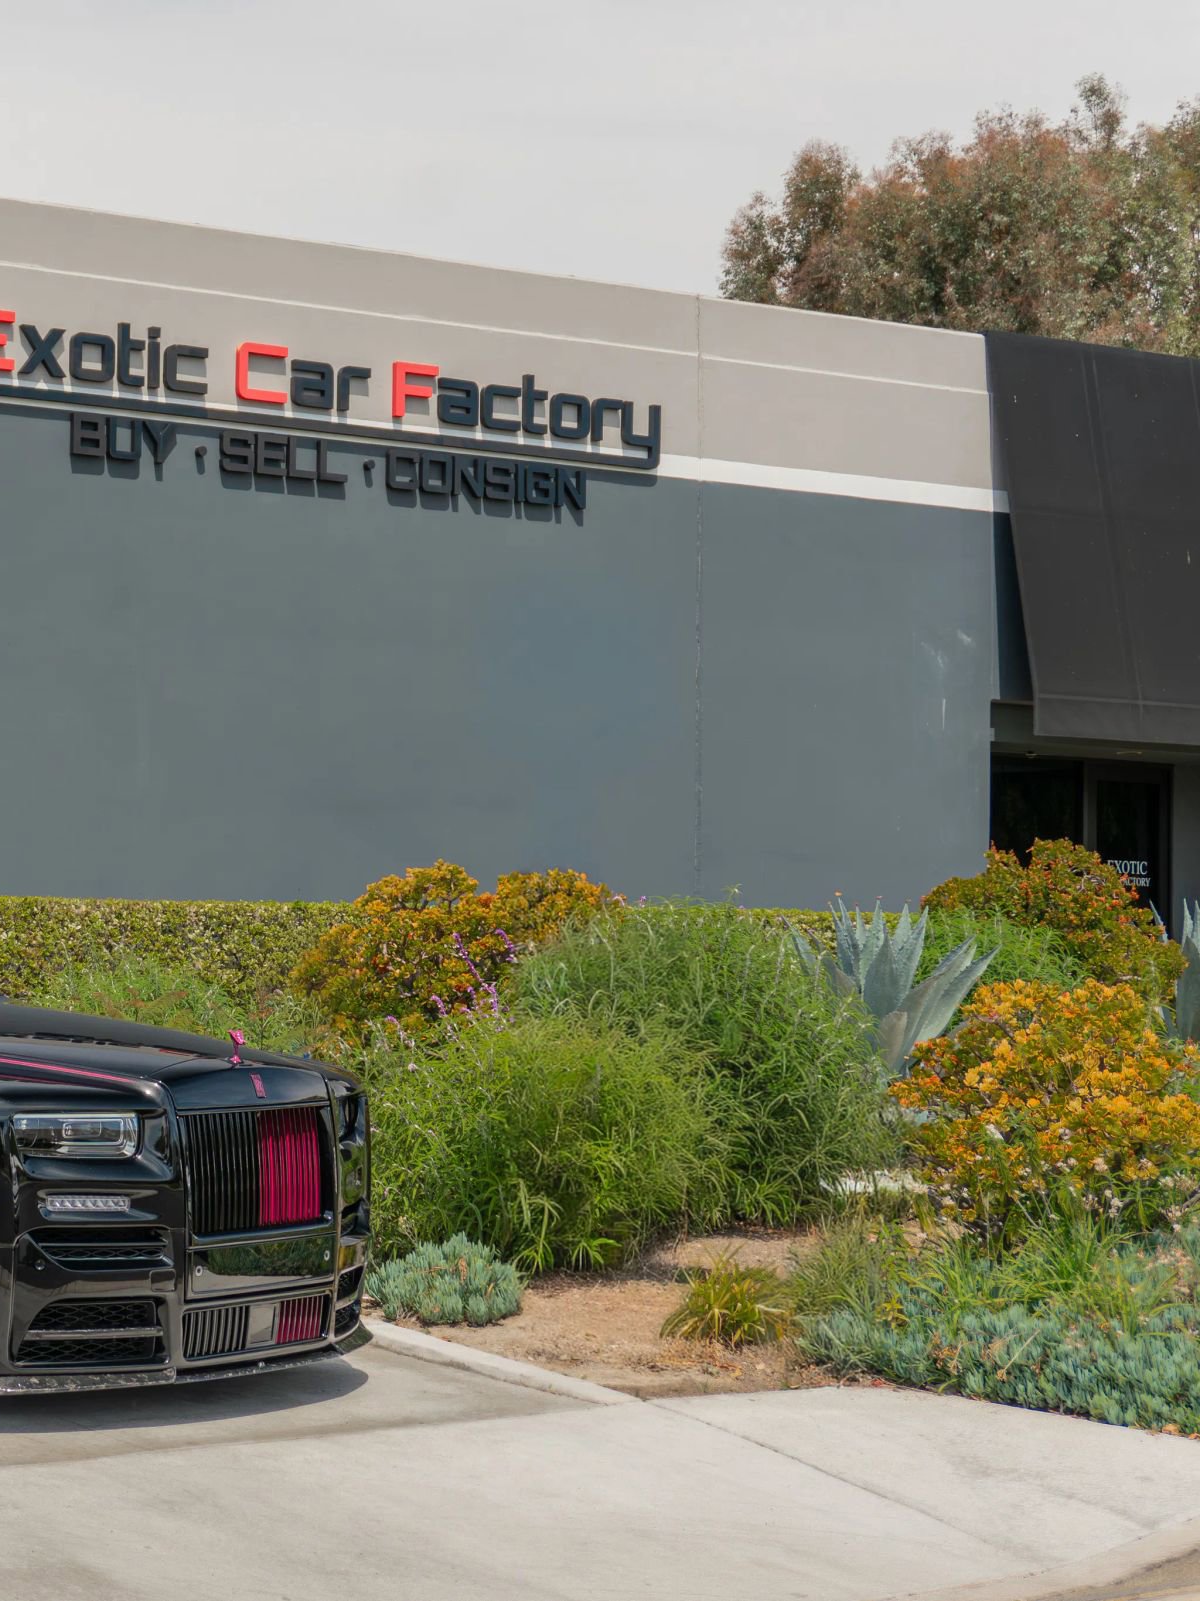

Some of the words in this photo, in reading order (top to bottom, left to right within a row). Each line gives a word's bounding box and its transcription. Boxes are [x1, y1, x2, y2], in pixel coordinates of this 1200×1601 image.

[235, 341, 372, 412] Car
[391, 360, 661, 470] Factory
[69, 412, 178, 464] BUY
[218, 429, 348, 484] SELL
[385, 447, 587, 510] CONSIGN
[1121, 877, 1151, 887] ACTORY
